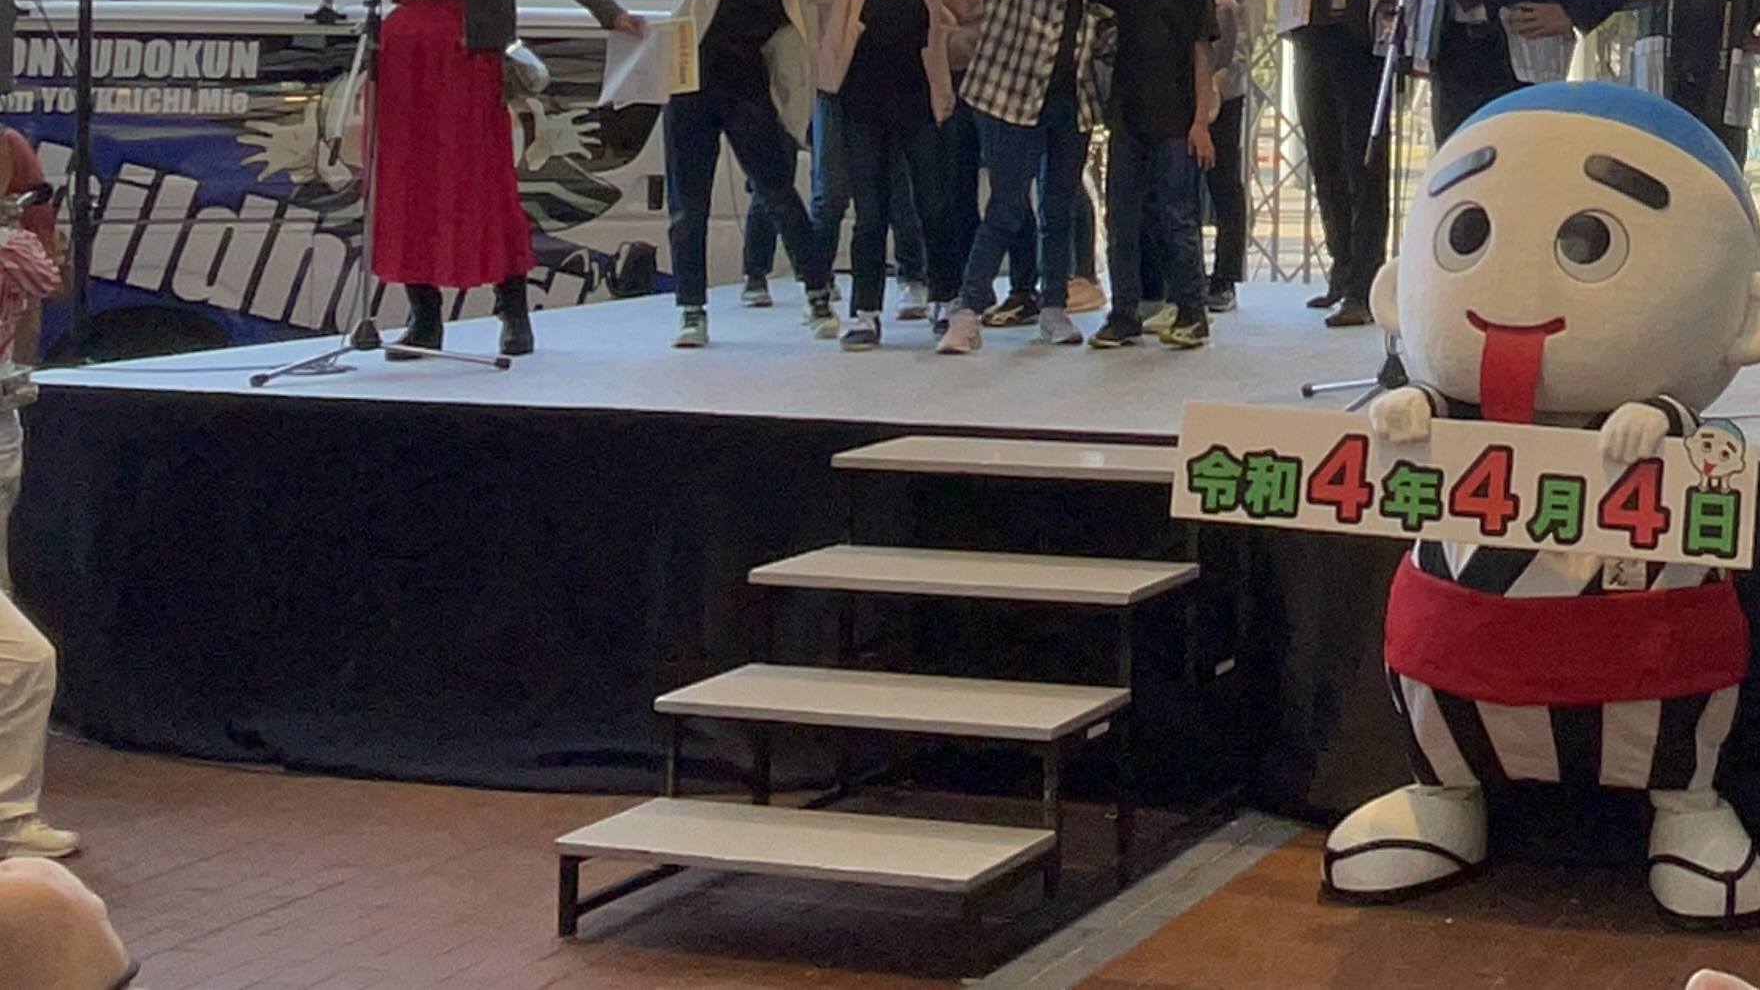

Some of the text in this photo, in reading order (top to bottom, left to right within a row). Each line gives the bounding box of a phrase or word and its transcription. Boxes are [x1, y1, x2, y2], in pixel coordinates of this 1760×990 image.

[1187, 433, 1741, 557] 令和4年4月4日
